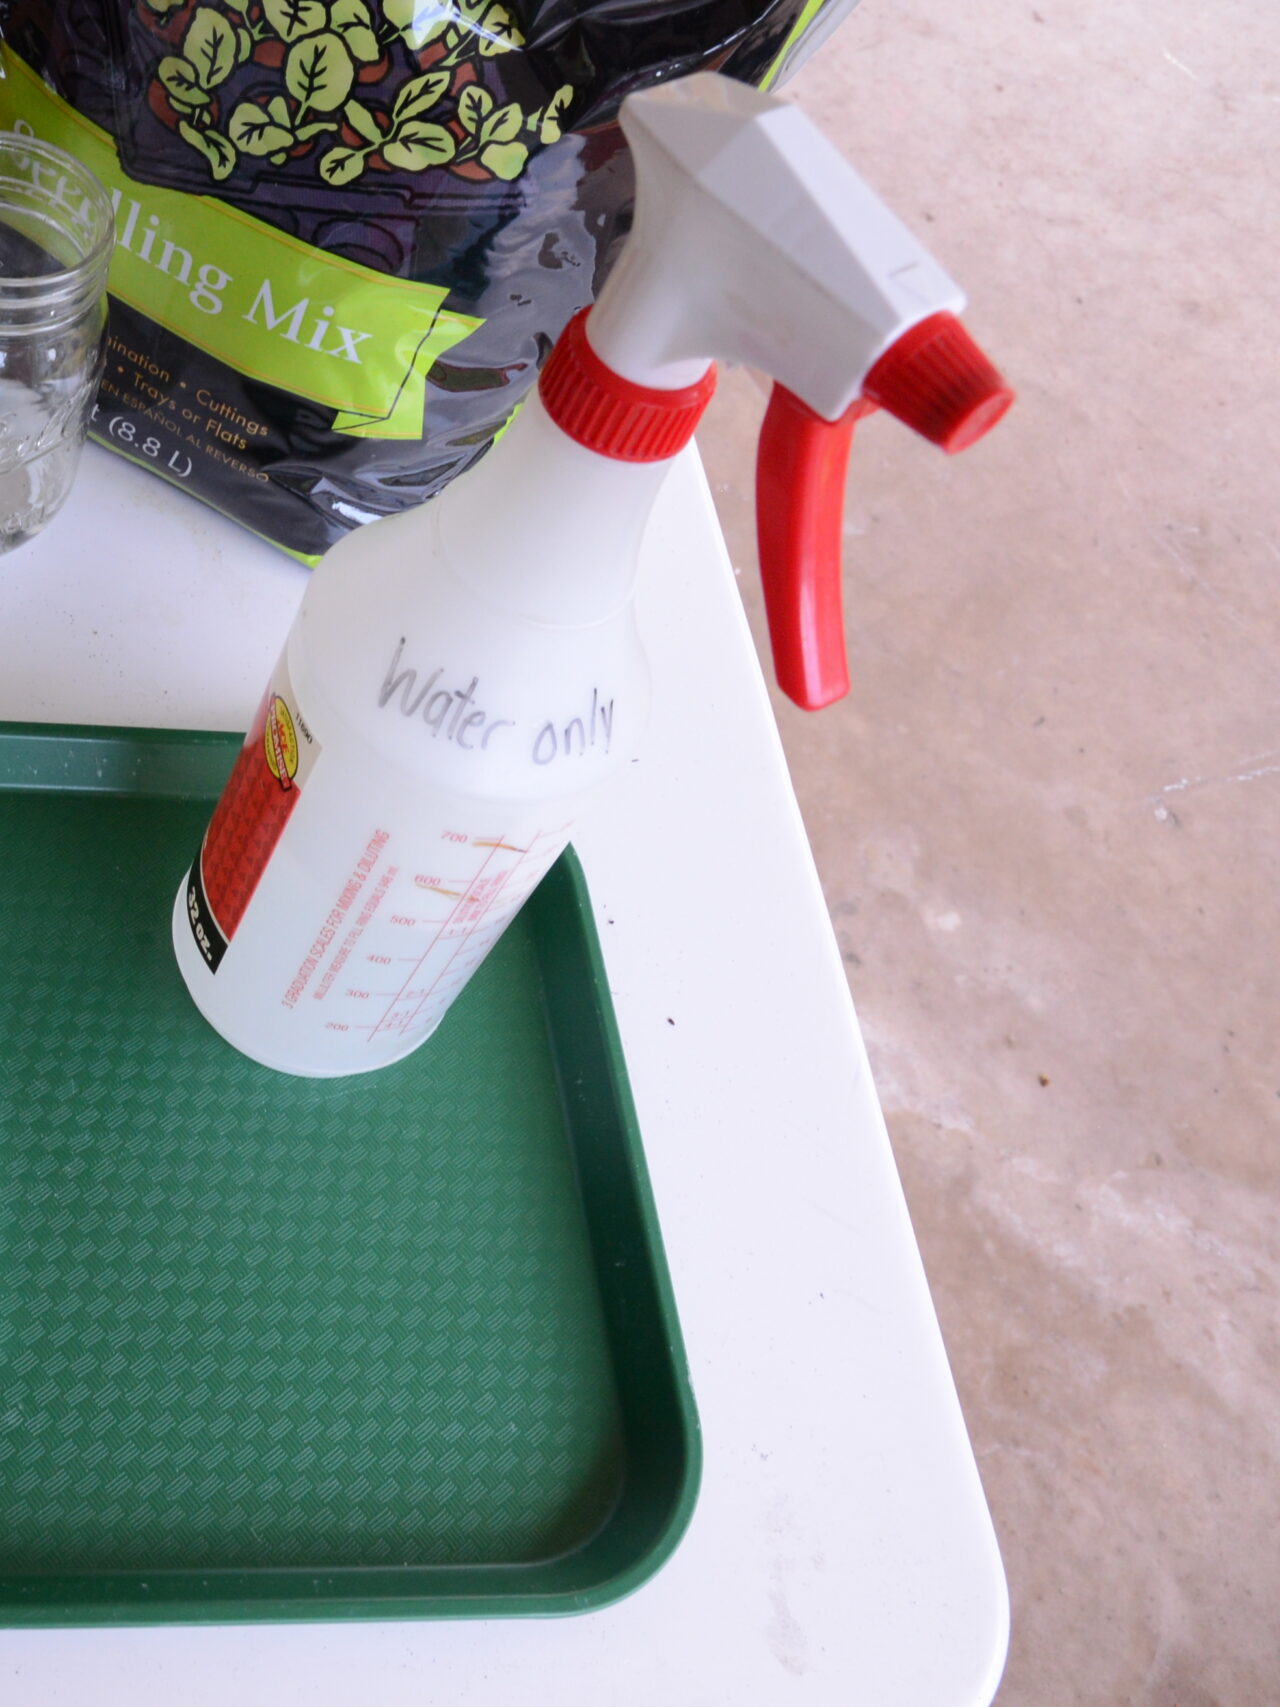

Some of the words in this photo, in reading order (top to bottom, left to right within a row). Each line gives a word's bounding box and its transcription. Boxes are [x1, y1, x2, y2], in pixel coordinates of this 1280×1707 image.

[242, 279, 373, 364] Mix
[134, 372, 176, 411] Trays
[182, 408, 201, 424] or
[205, 419, 248, 450] Flats
[196, 389, 268, 436] Cuttings
[108, 416, 161, 457] (8.8
[168, 450, 193, 478] L)
[123, 393, 182, 438] ESPAÑOL
[186, 433, 202, 448] AL
[205, 444, 270, 483] REVERSO
[377, 636, 516, 750] Water
[532, 687, 614, 766] only
[440, 830, 468, 844] 700
[414, 874, 441, 887] 600
[389, 914, 416, 927] 500
[367, 953, 391, 965] 400
[345, 988, 370, 1000] 300
[324, 1021, 349, 1033] 200
